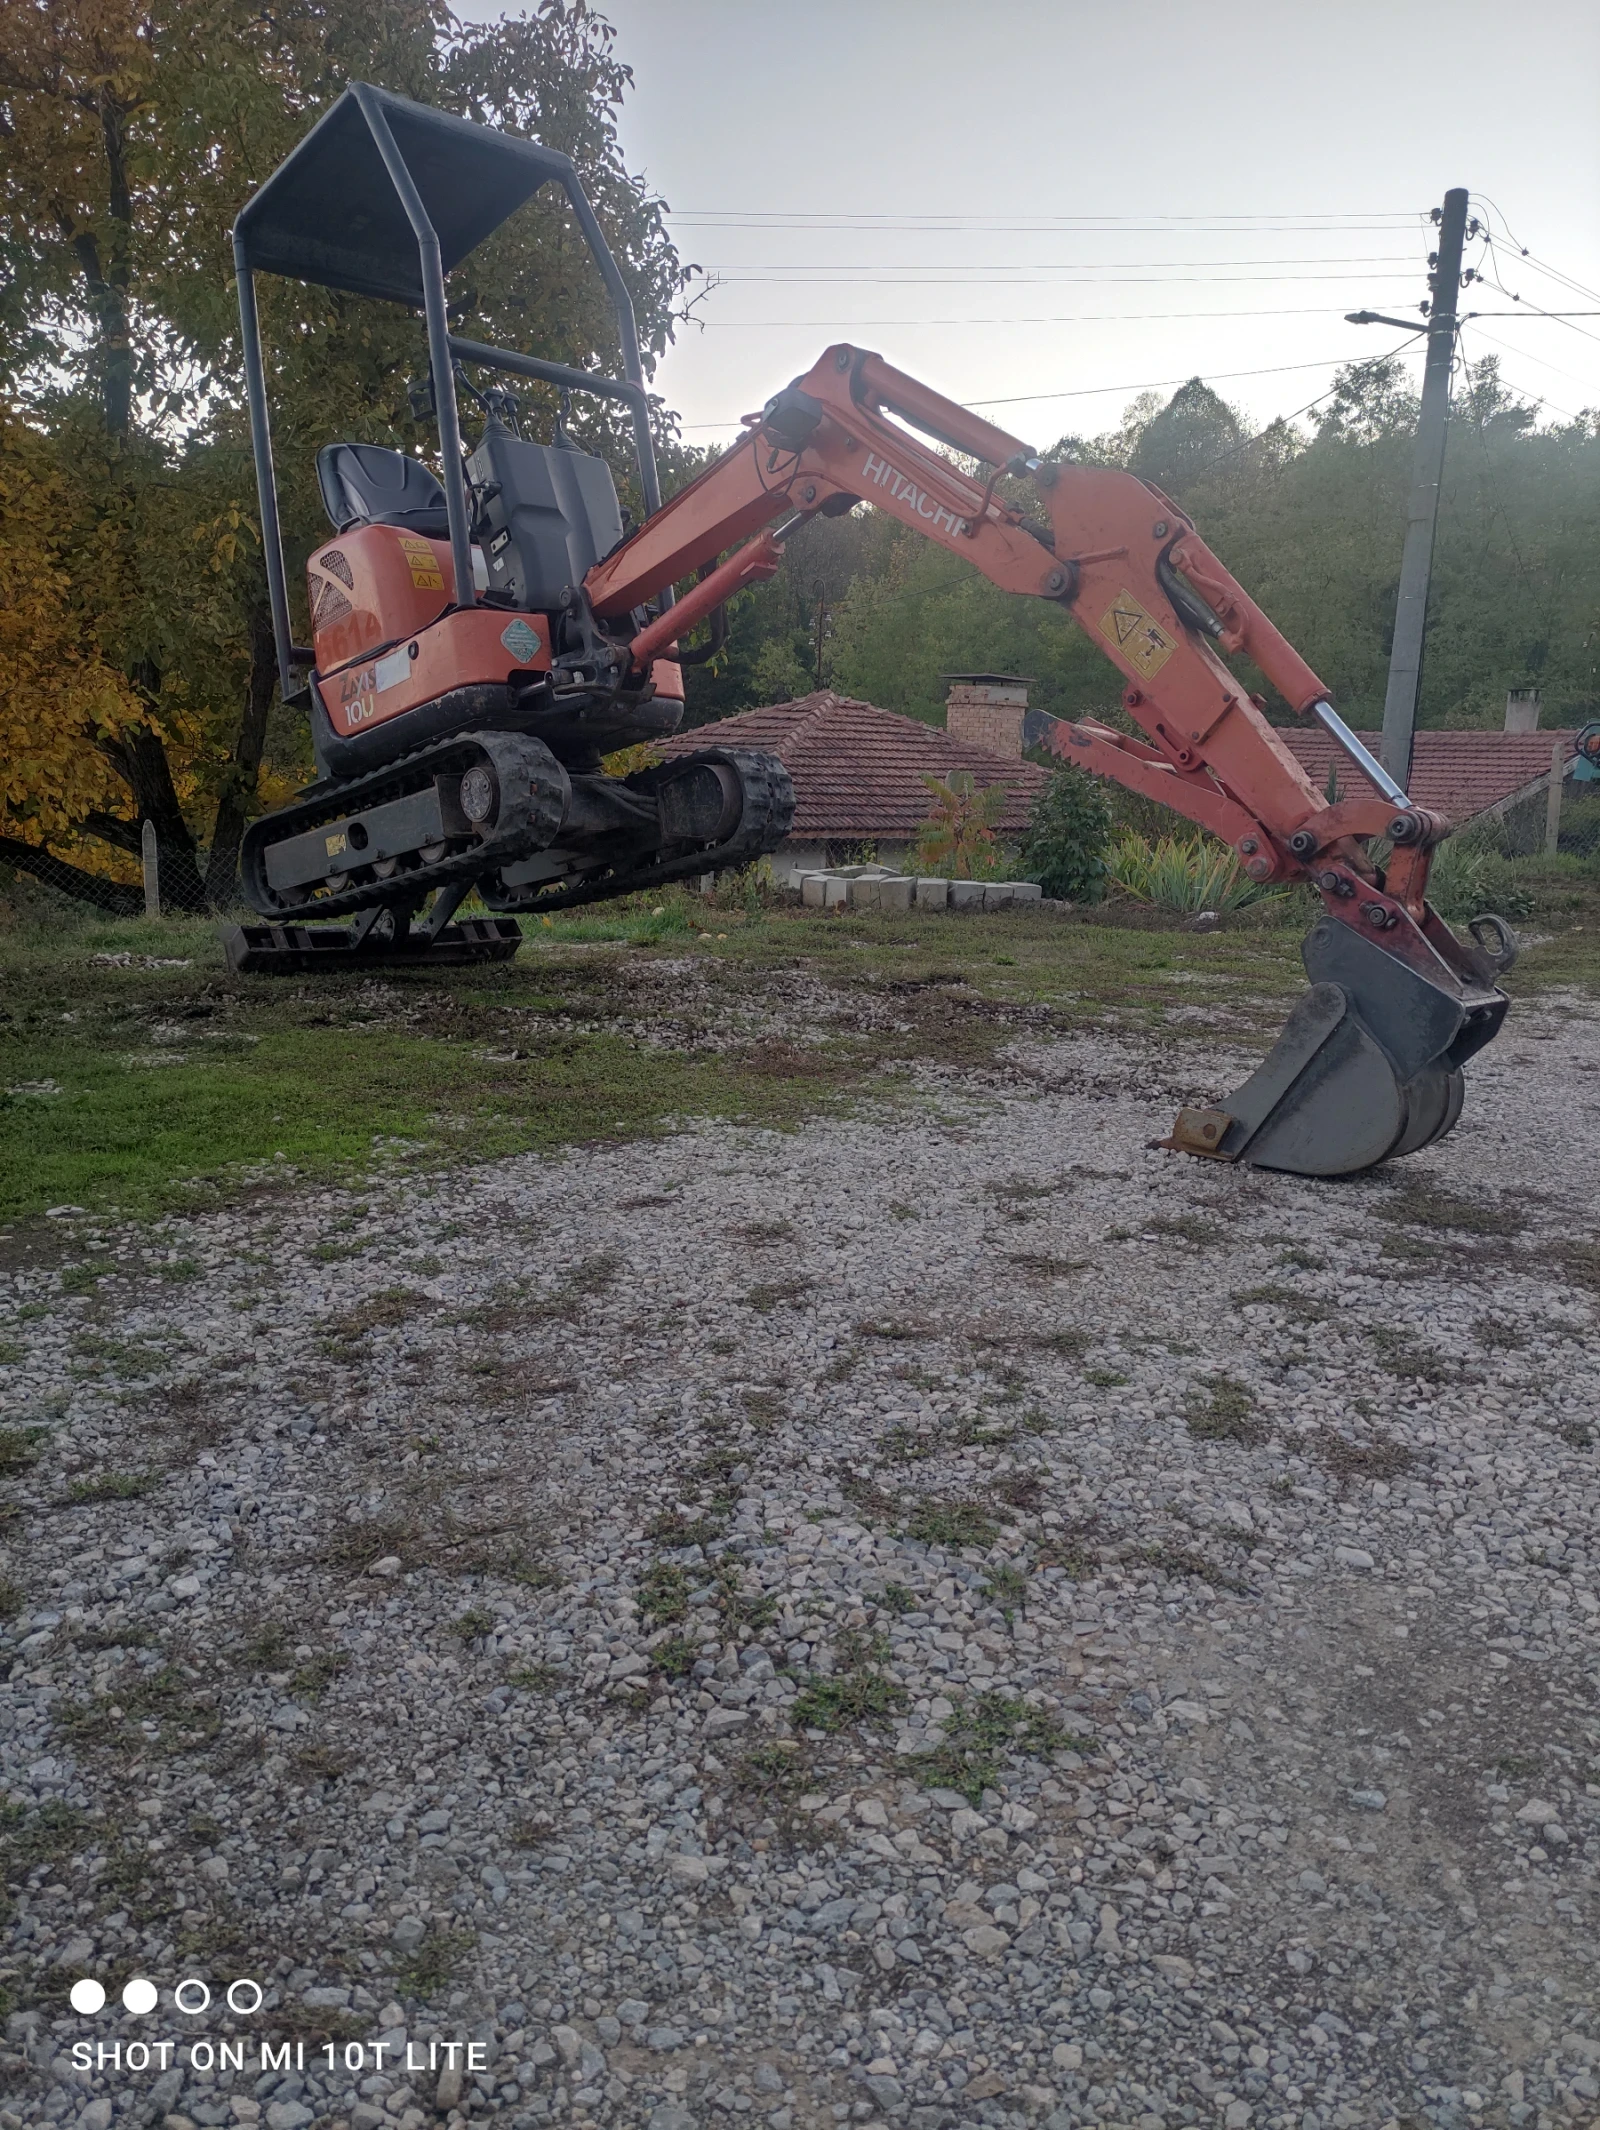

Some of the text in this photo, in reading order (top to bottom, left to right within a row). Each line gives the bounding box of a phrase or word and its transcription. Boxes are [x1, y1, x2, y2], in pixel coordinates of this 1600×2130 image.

[862, 452, 965, 537] HITACHI
[339, 668, 376, 703] ZAXIS
[345, 694, 374, 727] 10U
